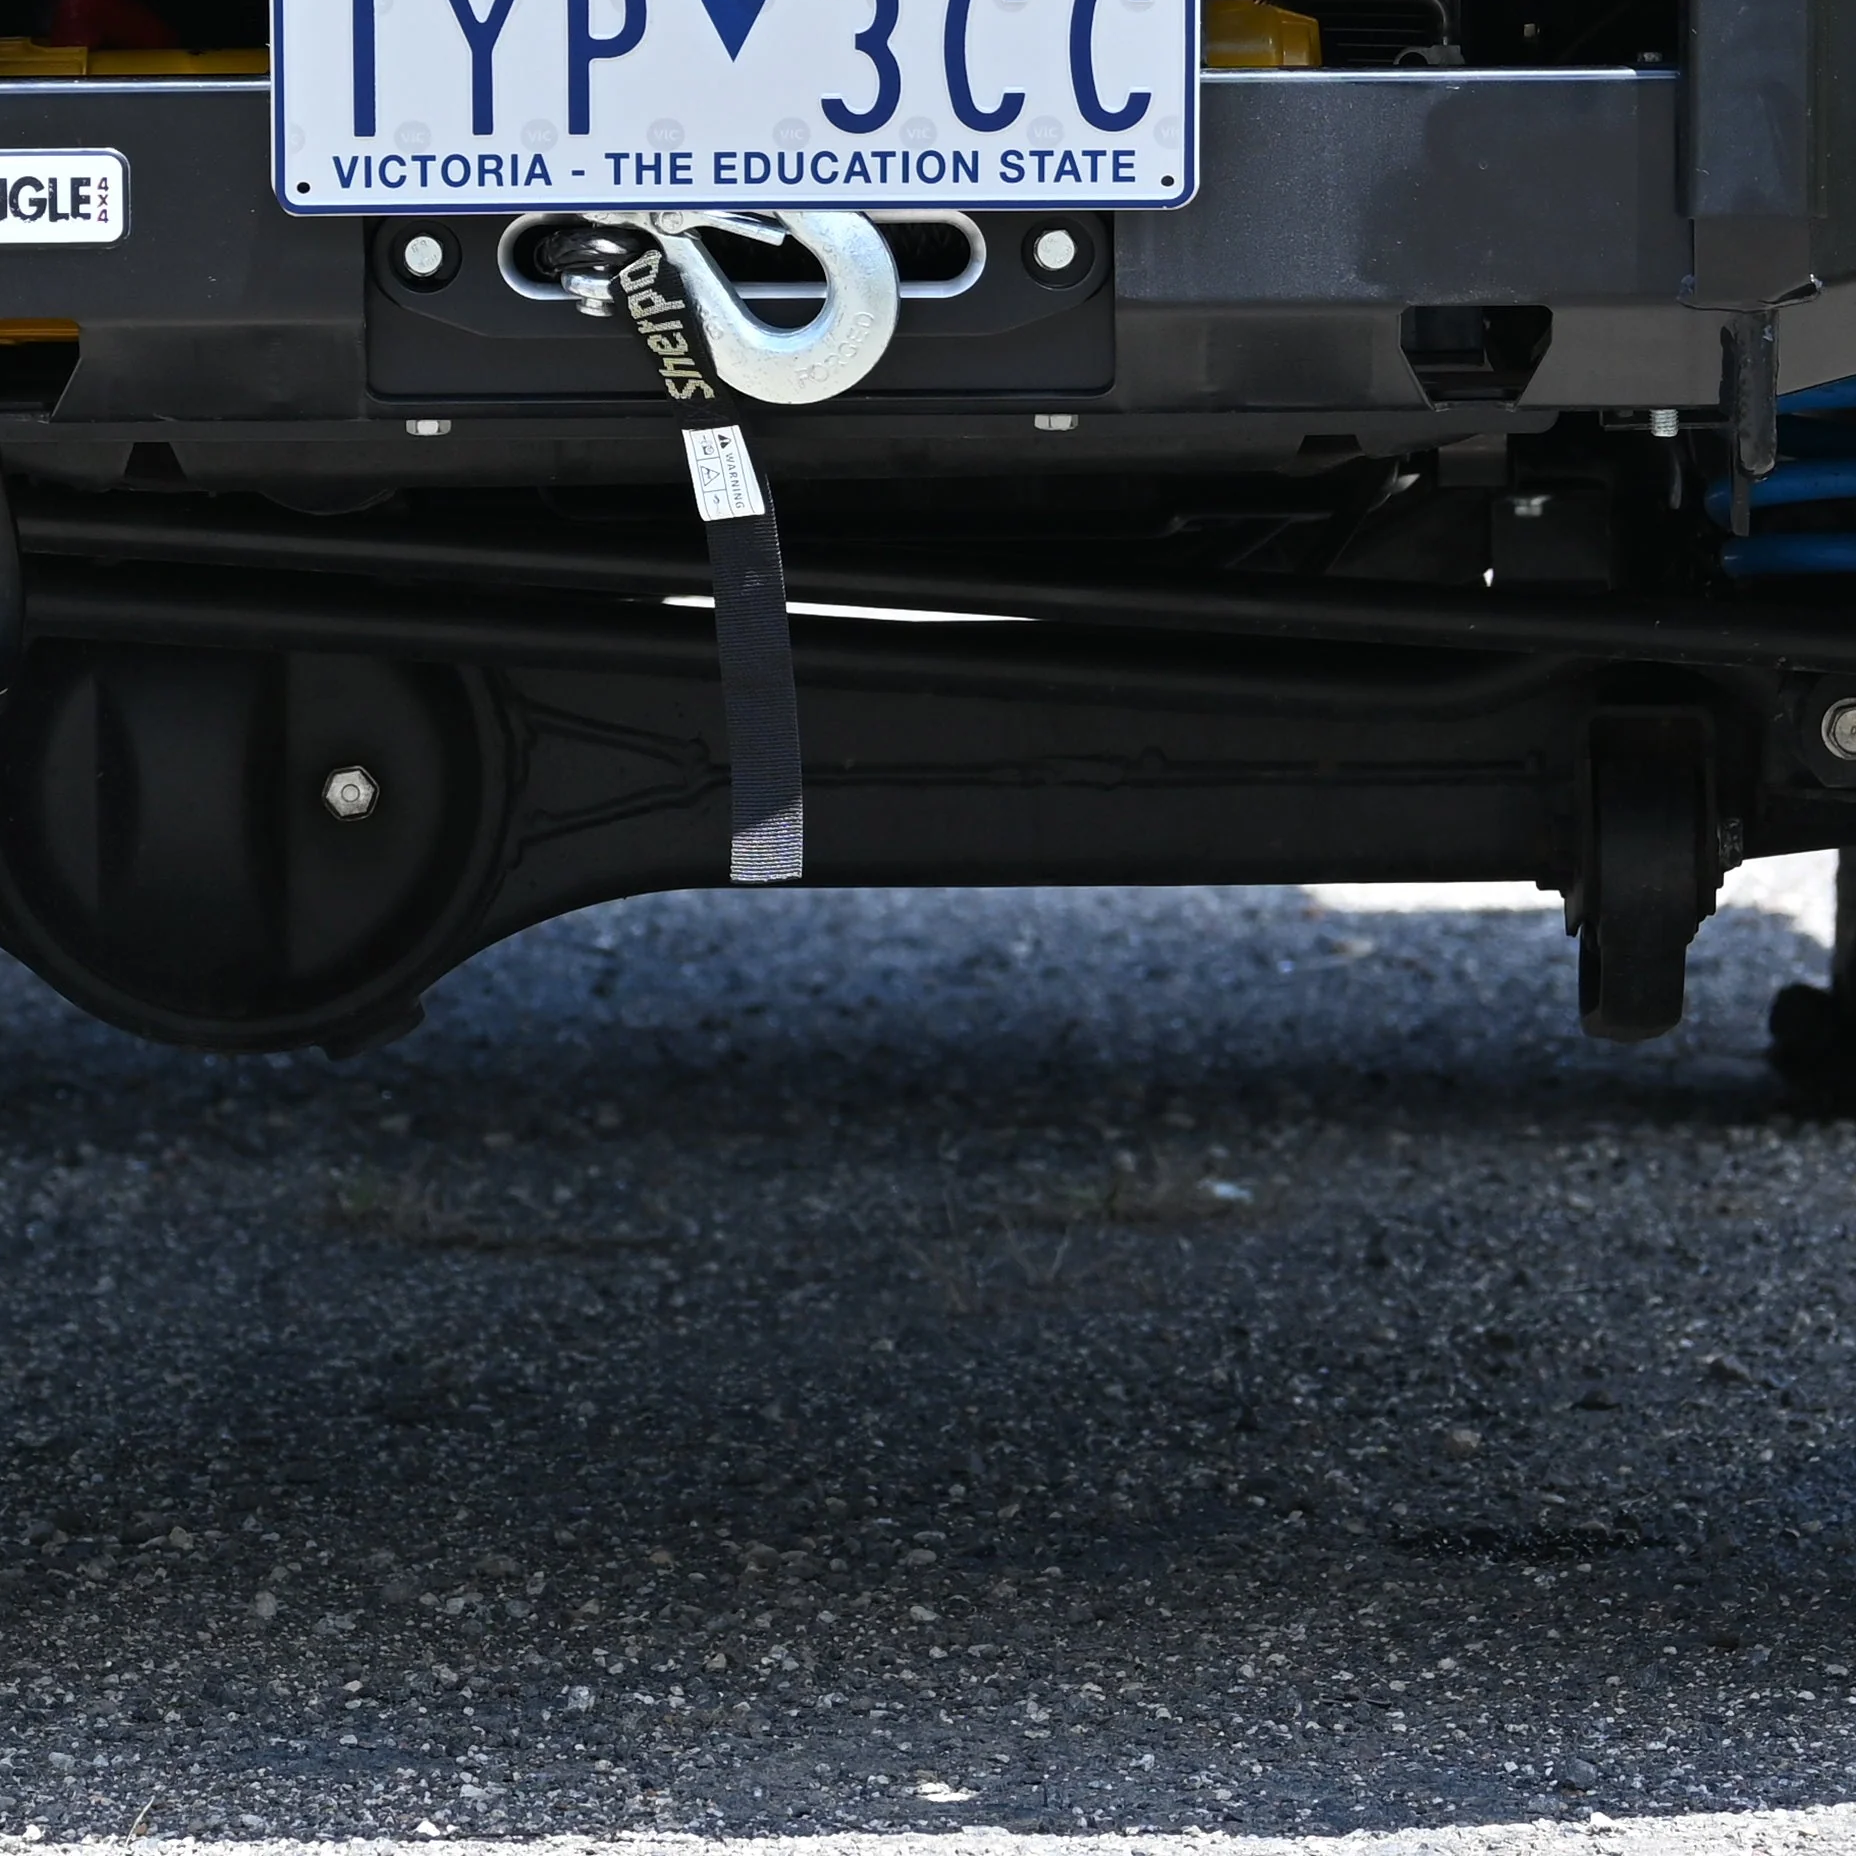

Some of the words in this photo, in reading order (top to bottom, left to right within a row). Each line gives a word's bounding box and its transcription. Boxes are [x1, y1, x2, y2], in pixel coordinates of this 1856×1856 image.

[332, 153, 553, 189] VICTORIA
[604, 152, 693, 186] THE
[713, 150, 979, 185] EDUCATION
[999, 149, 1136, 184] STATE
[724, 452, 745, 510] WARNING
